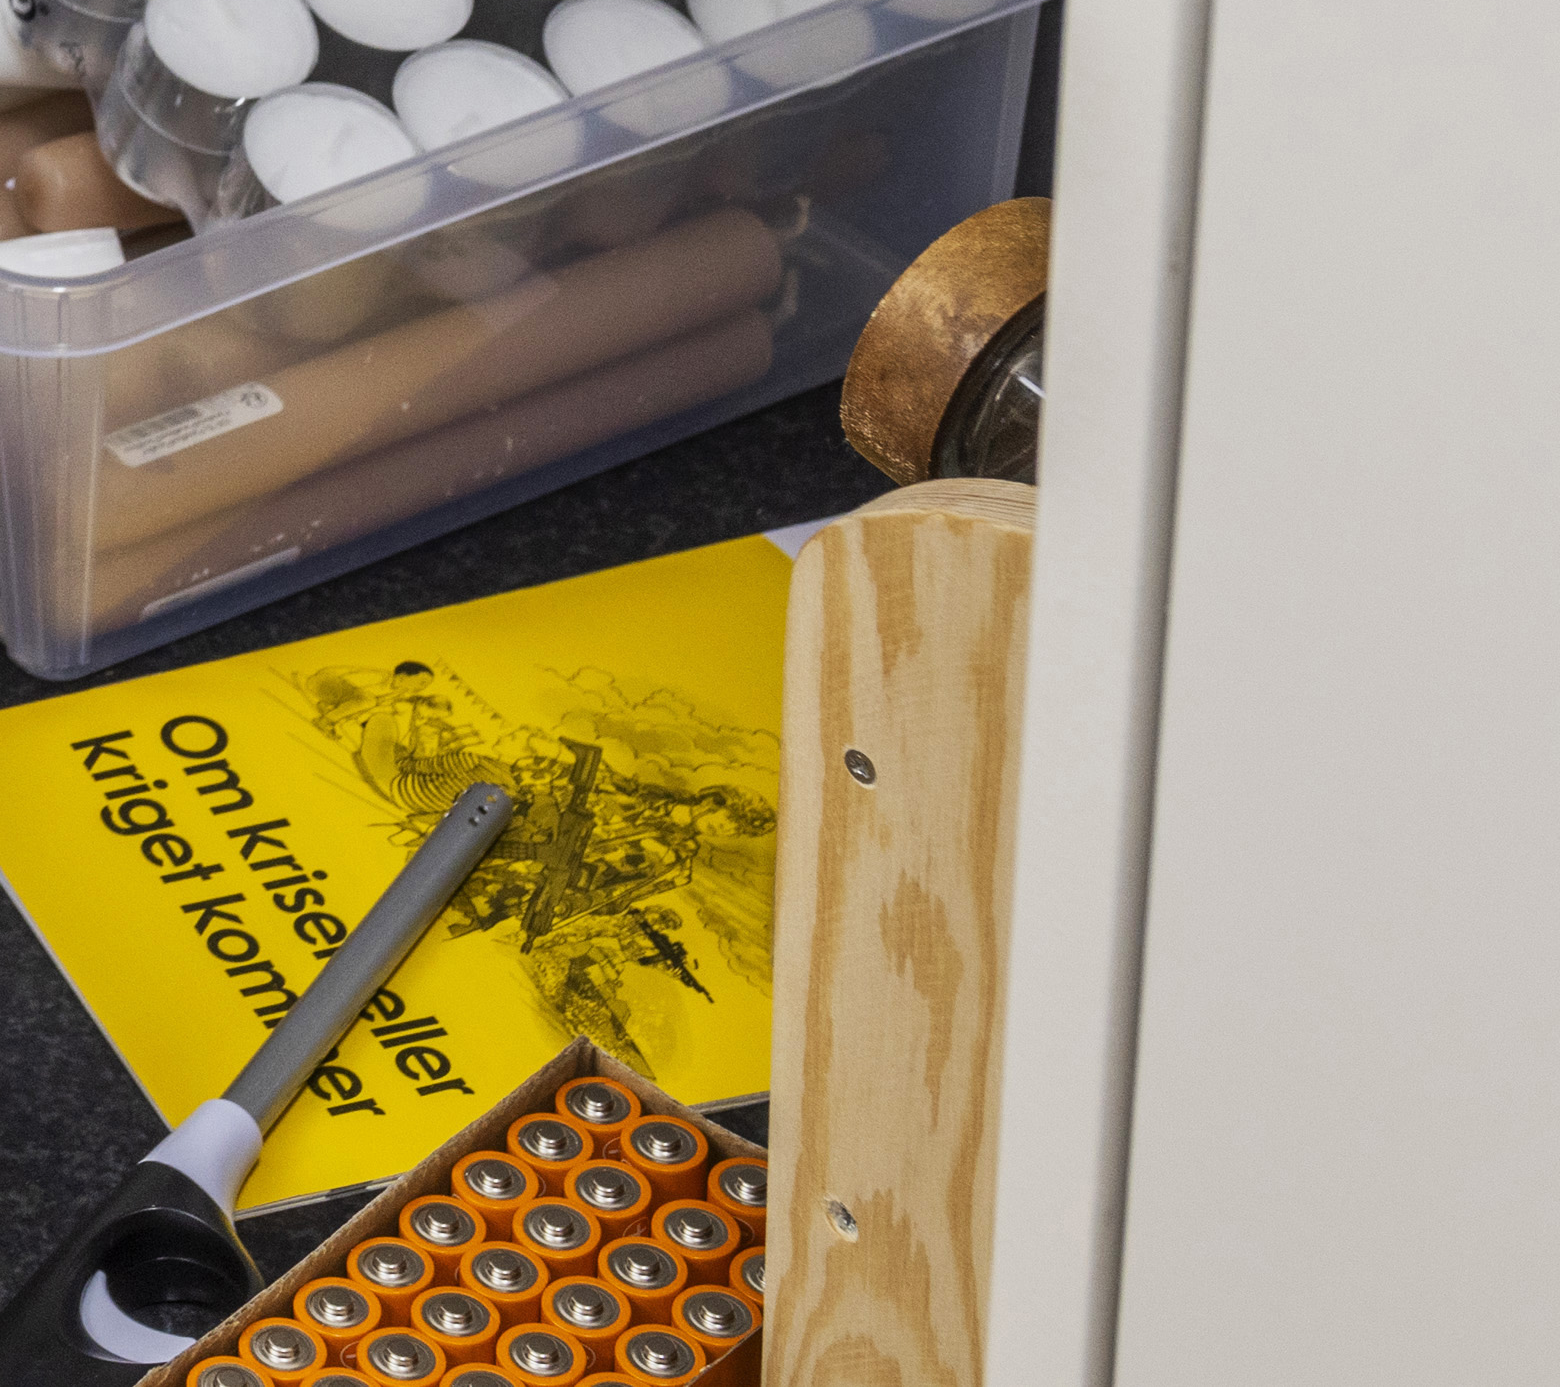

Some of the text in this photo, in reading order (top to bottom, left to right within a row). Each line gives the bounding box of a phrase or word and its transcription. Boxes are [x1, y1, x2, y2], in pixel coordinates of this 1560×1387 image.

[70, 730, 386, 1117] kriget komer
[161, 715, 475, 1097] Om krise eller
